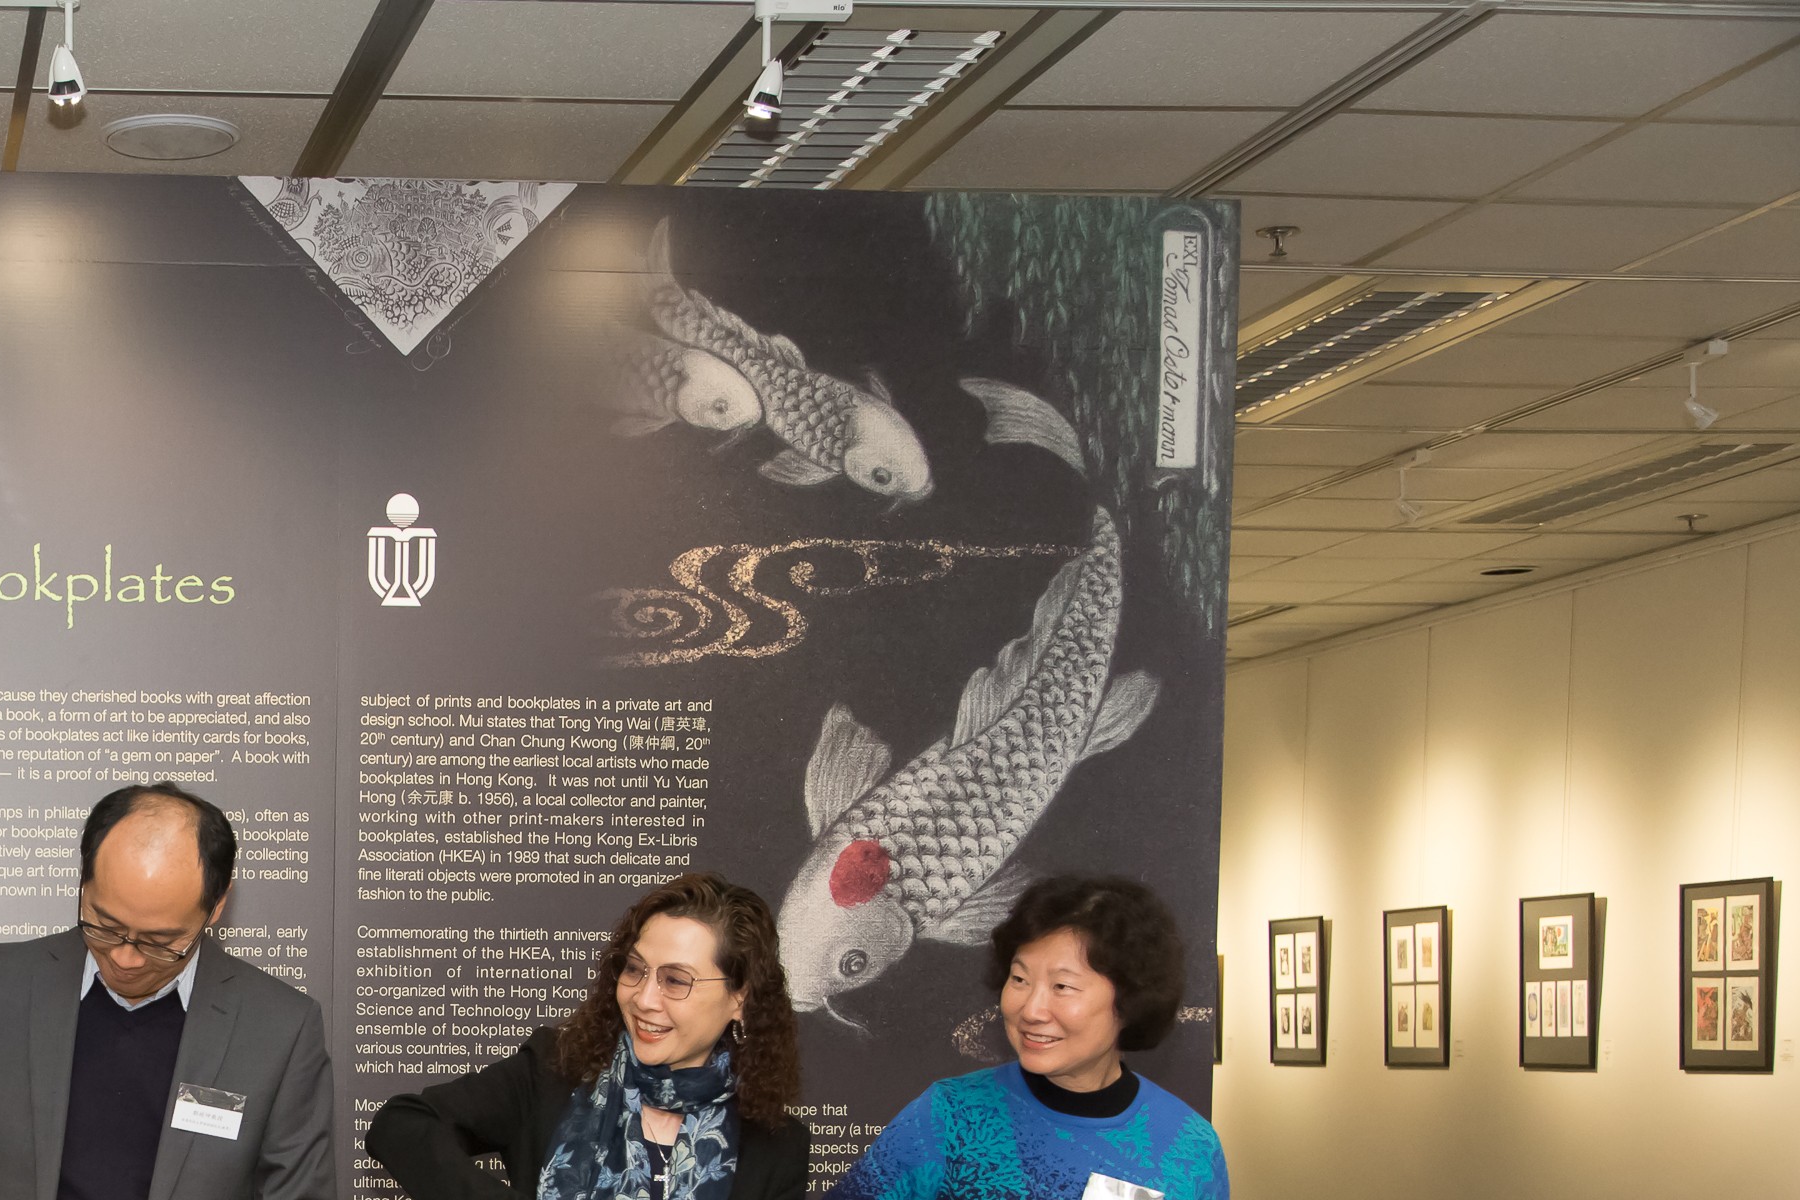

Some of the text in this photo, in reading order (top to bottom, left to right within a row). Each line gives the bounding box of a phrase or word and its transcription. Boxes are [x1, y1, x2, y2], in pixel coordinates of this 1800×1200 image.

[1161, 336, 1191, 463] Ostermann
[40, 689, 68, 704] they
[72, 690, 136, 703] cherished
[141, 691, 182, 704] books
[186, 691, 213, 704] with
[217, 693, 250, 707] great
[255, 692, 310, 705] affection
[361, 694, 712, 713] subject of prints and bookplates in a private art and
[9, 728, 22, 740] of
[26, 728, 99, 743] bookplates
[103, 730, 123, 742] act
[127, 730, 149, 742] like
[153, 730, 200, 745] identity
[203, 731, 240, 743] cards
[244, 731, 261, 744] for
[265, 731, 309, 746] books,
[360, 732, 385, 745] 20th
[391, 733, 444, 749] century)
[449, 734, 474, 747] and
[480, 734, 515, 747] Chan
[521, 734, 565, 751] Chung
[571, 736, 617, 752] Kwong
[685, 737, 710, 750] 20th
[360, 790, 396, 806] Hong
[459, 792, 471, 804] b.
[478, 792, 517, 808] 1956),
[523, 796, 531, 805] a
[536, 793, 565, 806] local
[570, 794, 626, 807] collector
[630, 795, 655, 807] and
[660, 795, 707, 810] painter,
